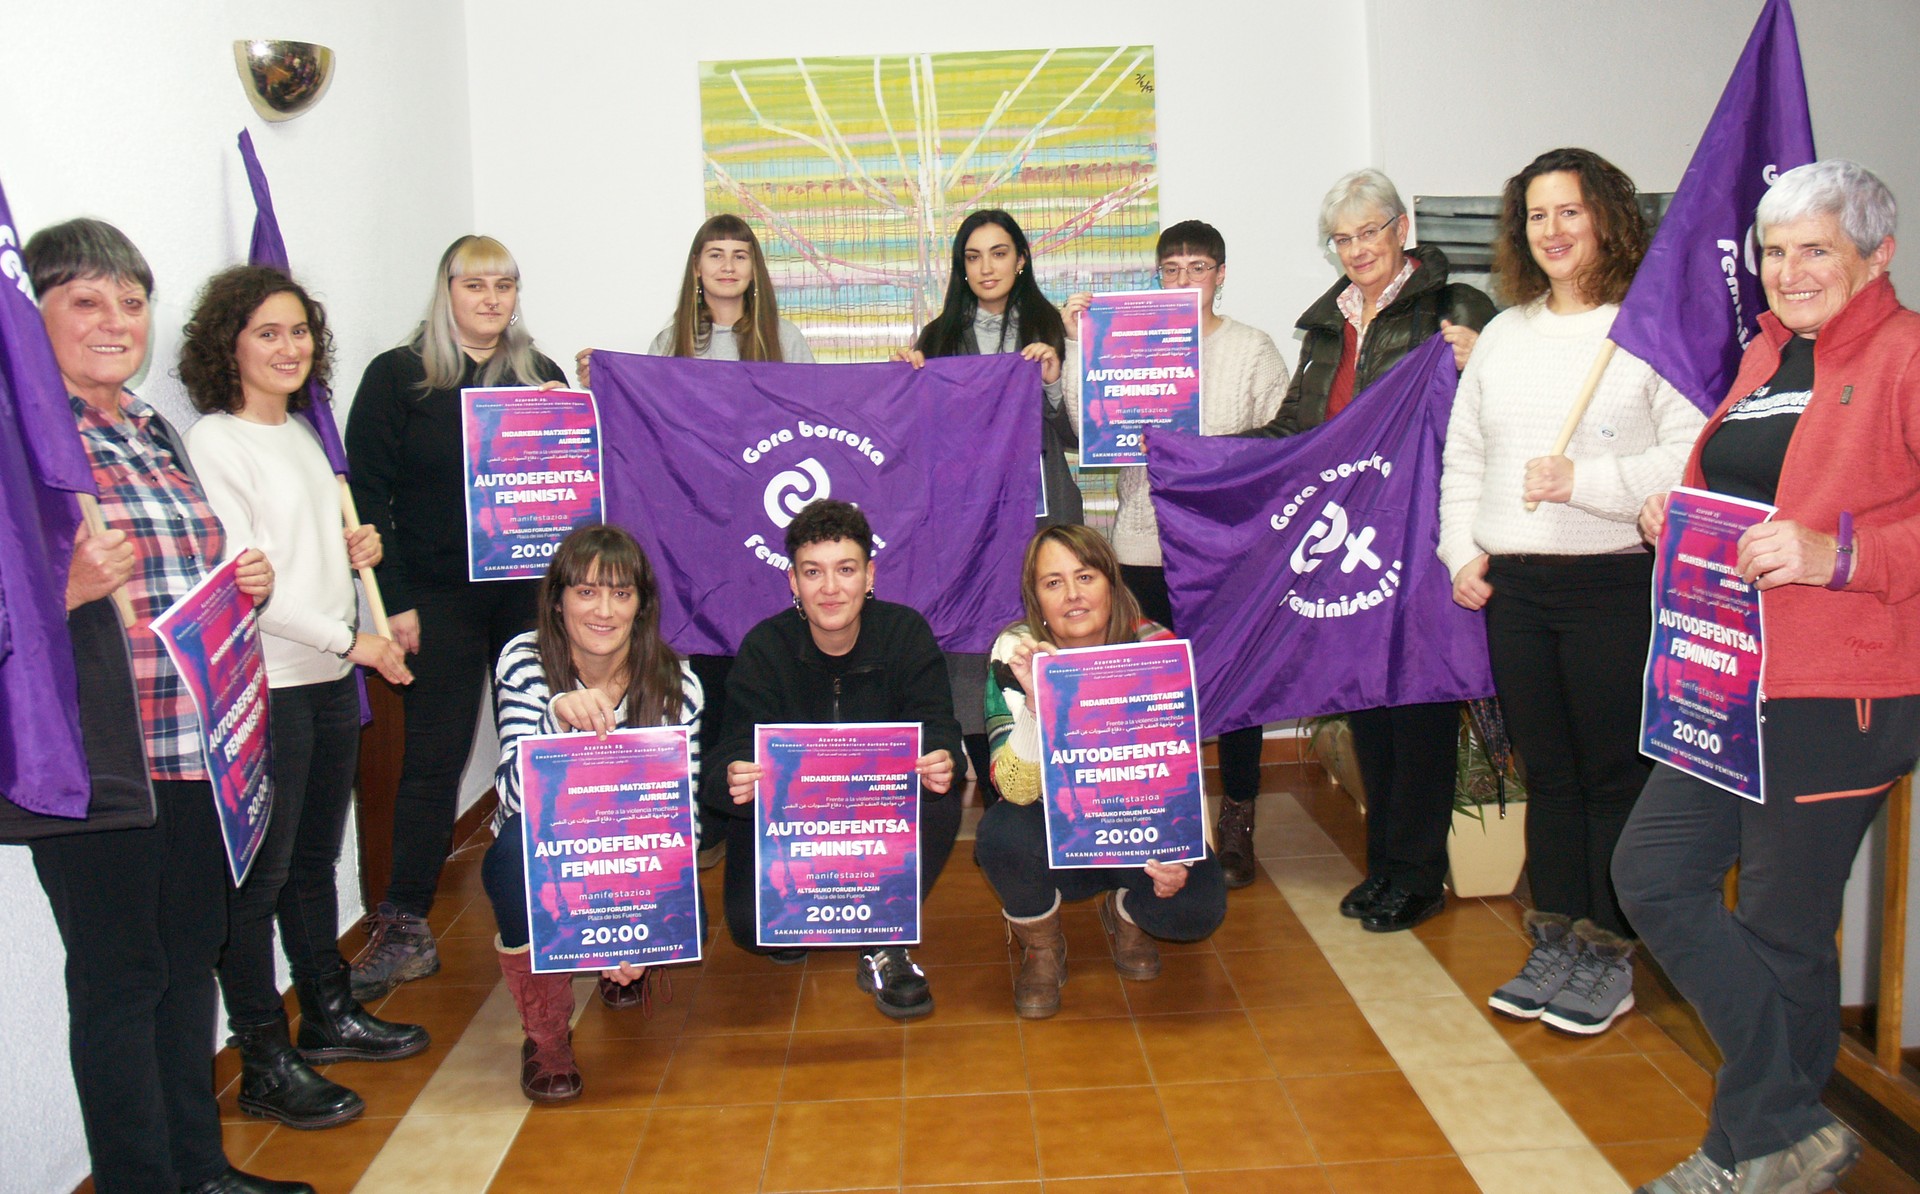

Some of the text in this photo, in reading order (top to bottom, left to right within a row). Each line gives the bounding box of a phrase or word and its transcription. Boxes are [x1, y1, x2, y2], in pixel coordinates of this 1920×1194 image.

[1086, 366, 1195, 382] AUTODEFENTSA
[1104, 384, 1178, 397] FEMINISTA
[743, 421, 885, 466] Gora borroka
[474, 470, 595, 487] AUTODEFENTSA
[495, 488, 577, 504] FEMINISTA
[1270, 485, 1318, 530] Gora
[1659, 608, 1758, 655] AUTODEFENTSA
[1670, 637, 1737, 676] FEMINISTA
[1080, 691, 1184, 707] INDARKERIA MATXISTAREN
[1676, 679, 1725, 702] manifestazioa
[1147, 702, 1184, 712] AURREAN
[1673, 720, 1721, 754] 20:00
[1051, 739, 1190, 764] AUTODEFENTSA
[851, 773, 907, 781] MATXISTAREN
[1075, 763, 1170, 783] FEMINISTA
[1715, 762, 1748, 783] FEMINISTA
[568, 781, 678, 795] INDARKERIA MATXISTAREN
[868, 783, 907, 791] AURREAN
[639, 792, 679, 802] AURREAN
[1092, 794, 1160, 805] manifestazioa
[765, 818, 910, 836] AUTODEFENTSA
[1095, 827, 1158, 844] 20:00
[535, 832, 685, 858] AUTODEFENTSA
[790, 840, 887, 857] FEMINISTA
[1152, 845, 1190, 854] FEMINISTA
[561, 856, 662, 878] FEMINISTA
[806, 871, 874, 879] manifestazioa
[579, 888, 650, 900] manifestazioa
[570, 907, 606, 916] ALTSASUKO
[607, 905, 632, 913] FORUEN
[805, 904, 870, 921] 20:00
[581, 924, 649, 945] 20:00
[592, 949, 640, 958] MUGIMENDU
[642, 944, 683, 954] FEMINISTA
